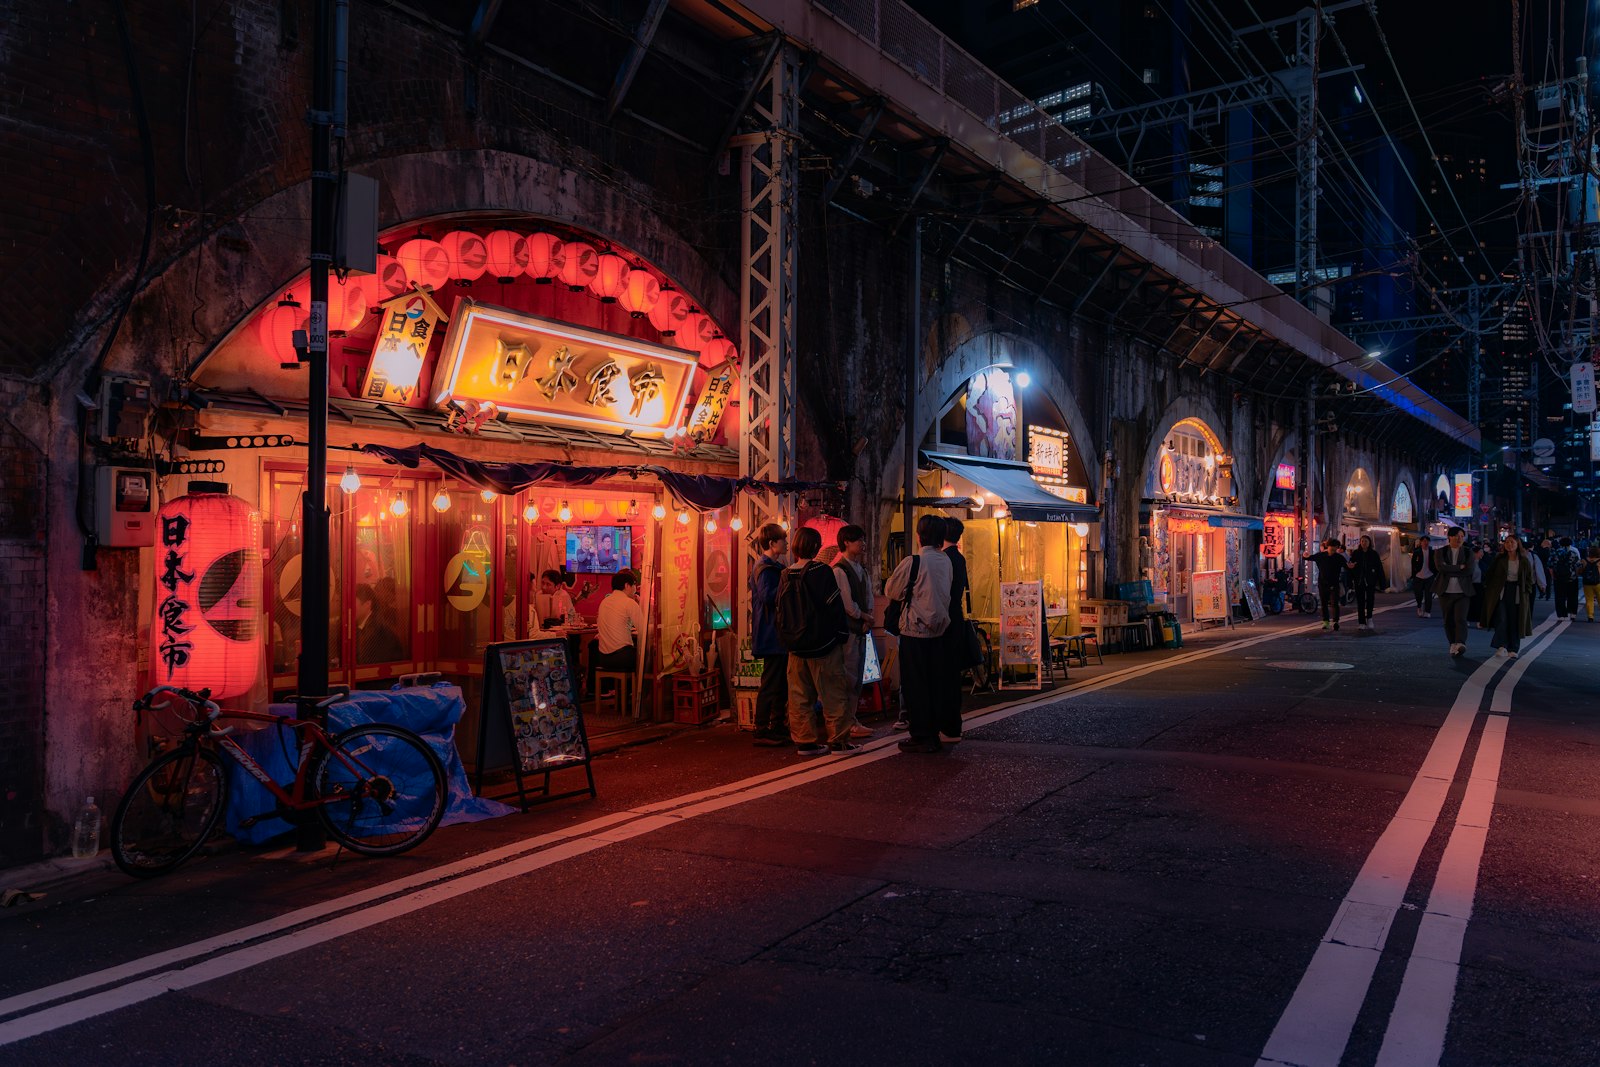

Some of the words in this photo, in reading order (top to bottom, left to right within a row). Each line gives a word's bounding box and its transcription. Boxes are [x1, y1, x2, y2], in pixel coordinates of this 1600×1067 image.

[367, 311, 407, 398] 日本国
[393, 317, 430, 402] 食べべ
[490, 336, 664, 418] 日本食市
[692, 376, 720, 432] 日本全
[706, 380, 732, 440] 食べ比べ
[158, 513, 195, 682] 日本食市
